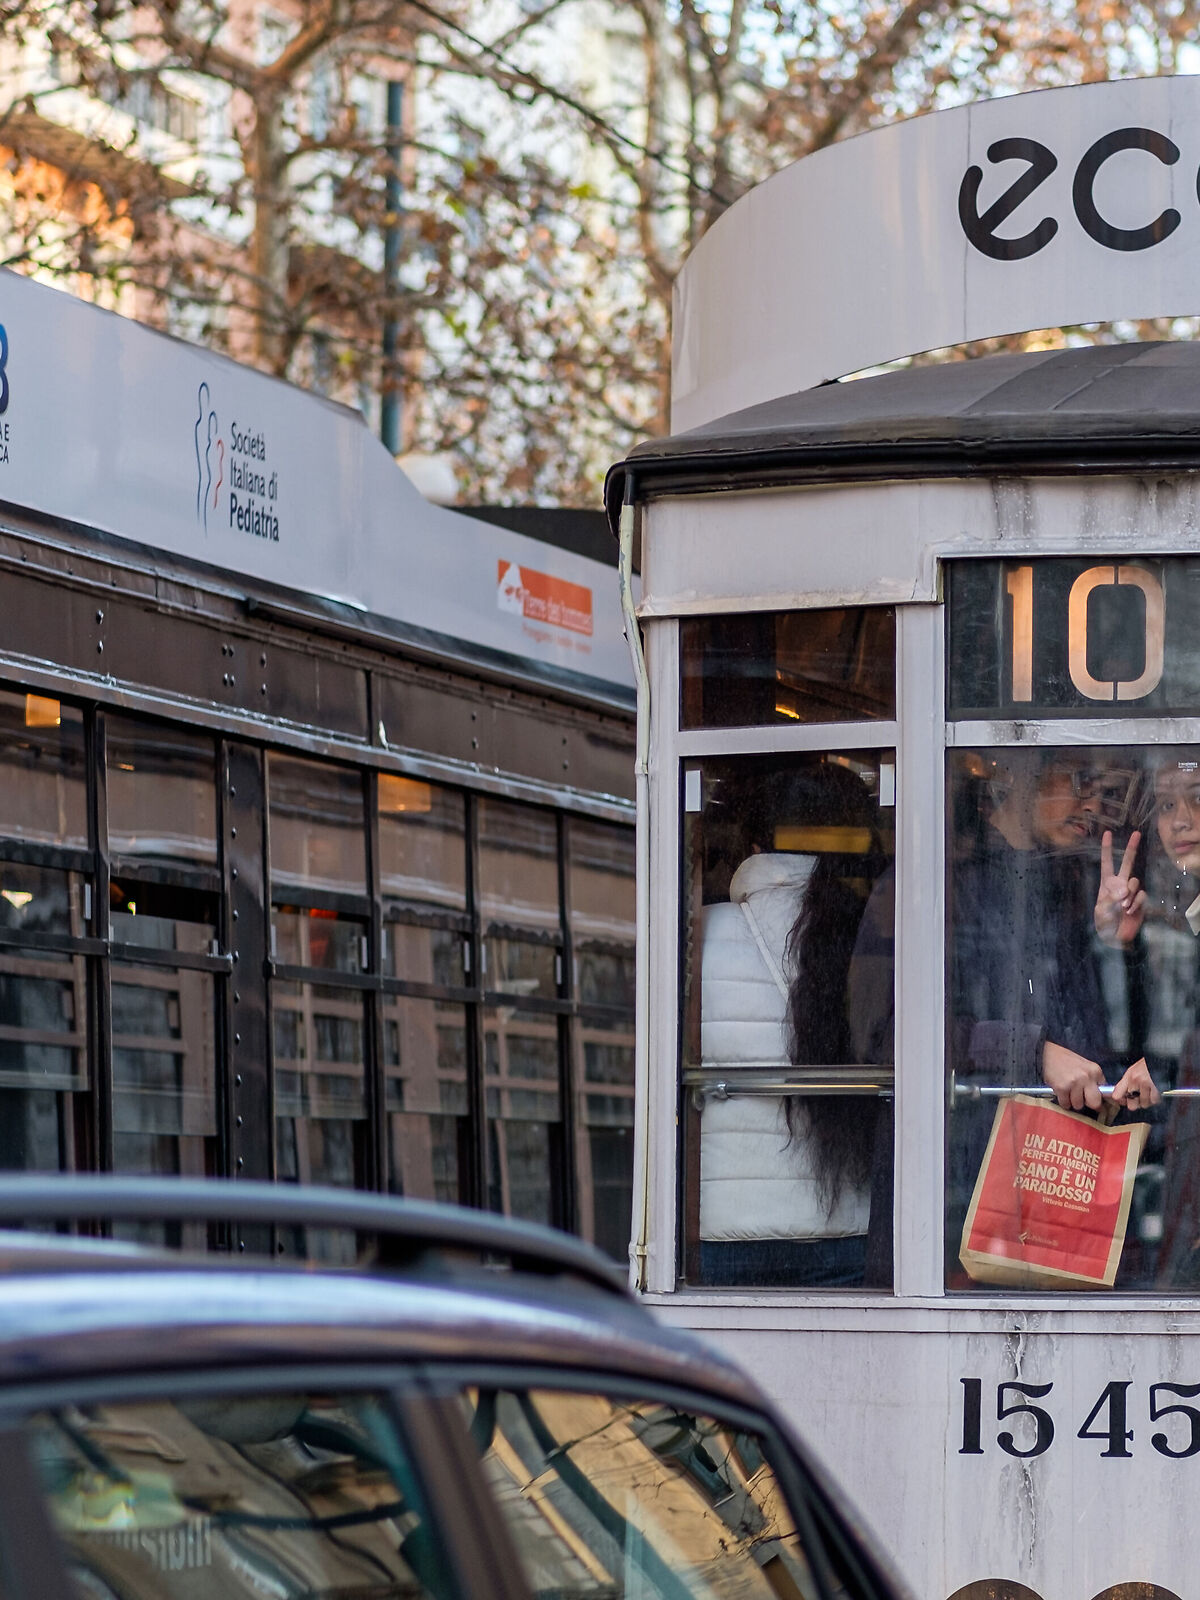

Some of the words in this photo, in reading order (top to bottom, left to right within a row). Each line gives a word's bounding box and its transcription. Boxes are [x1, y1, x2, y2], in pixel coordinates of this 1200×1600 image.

[231, 421, 266, 462] Società
[230, 457, 266, 497] Italiana
[268, 471, 278, 501] di
[229, 492, 280, 542] Pediatria
[1007, 565, 1165, 702] 10
[1021, 1147, 1098, 1177] PERFETTAMENTE
[1024, 1133, 1046, 1150] UN
[1046, 1138, 1101, 1168] ATTORE
[1012, 1176, 1093, 1205] PARADOSSO
[1018, 1160, 1059, 1182] SANO
[1060, 1166, 1073, 1185] È
[1074, 1173, 1097, 1192] UN
